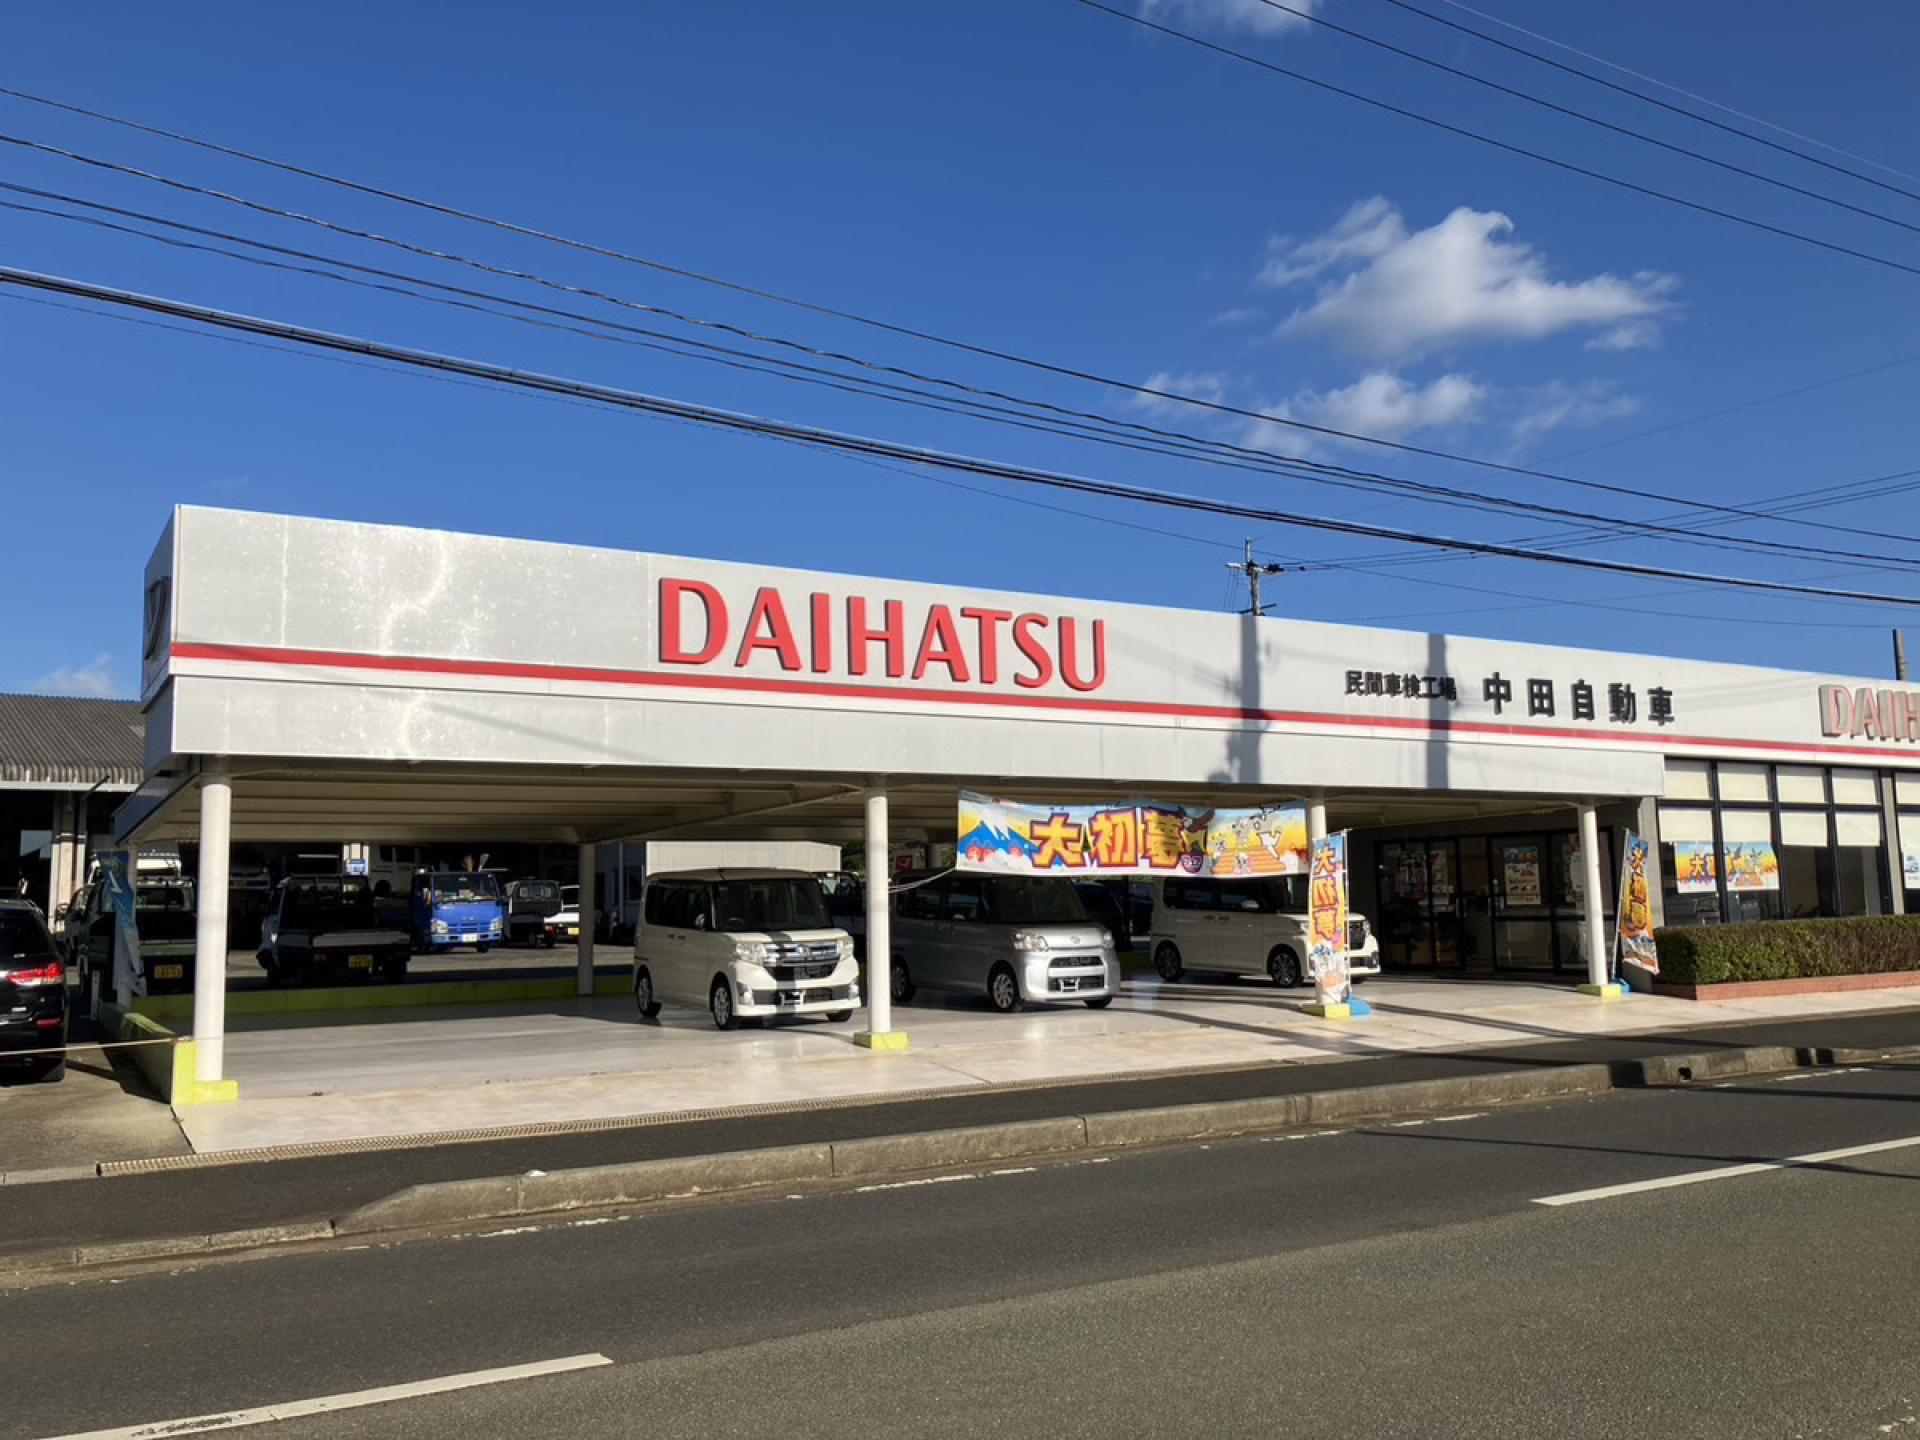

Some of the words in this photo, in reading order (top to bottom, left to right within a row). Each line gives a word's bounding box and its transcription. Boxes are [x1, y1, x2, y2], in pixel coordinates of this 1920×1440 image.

[659, 577, 1106, 691] DAIHATSU
[1344, 670, 1457, 701] 民間車検工場
[1483, 672, 1675, 726] 中田自動車
